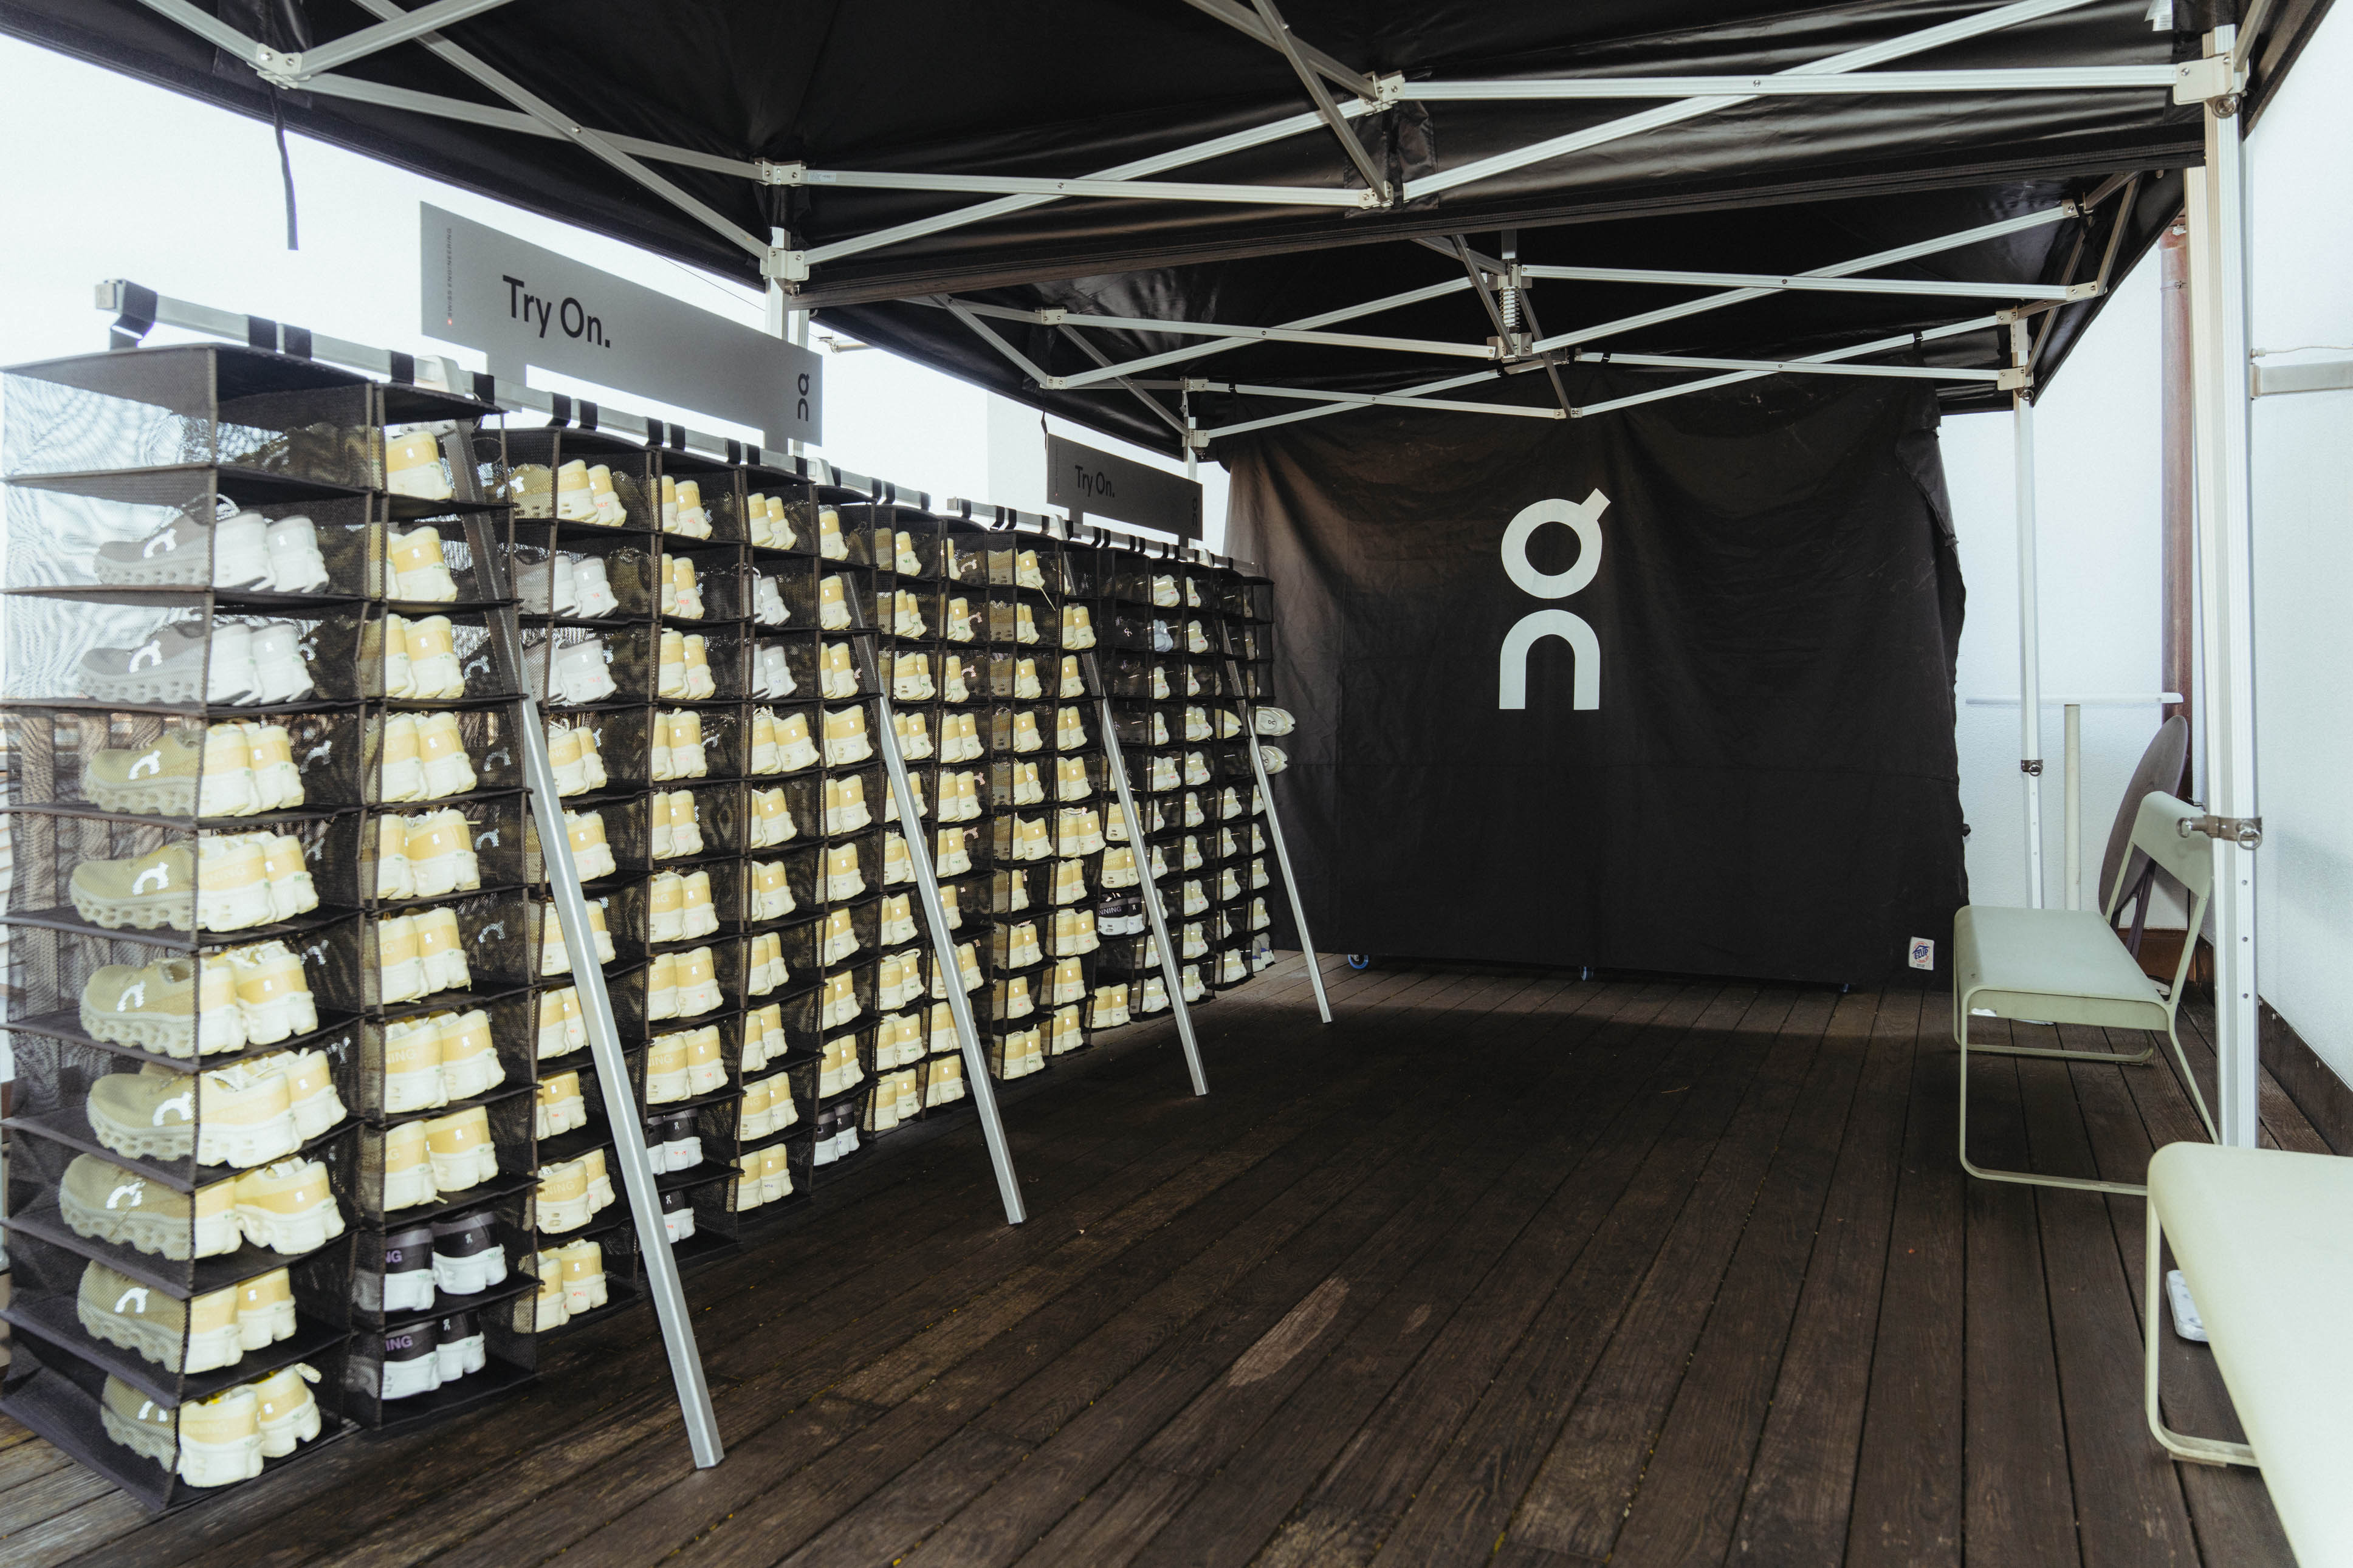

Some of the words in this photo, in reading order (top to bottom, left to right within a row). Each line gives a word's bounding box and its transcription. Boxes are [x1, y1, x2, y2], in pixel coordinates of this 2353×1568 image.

[503, 275, 552, 338] Try
[560, 297, 610, 348] On.
[1074, 465, 1093, 497] Try
[1096, 471, 1115, 498] On.
[1099, 906, 1122, 916] NNING
